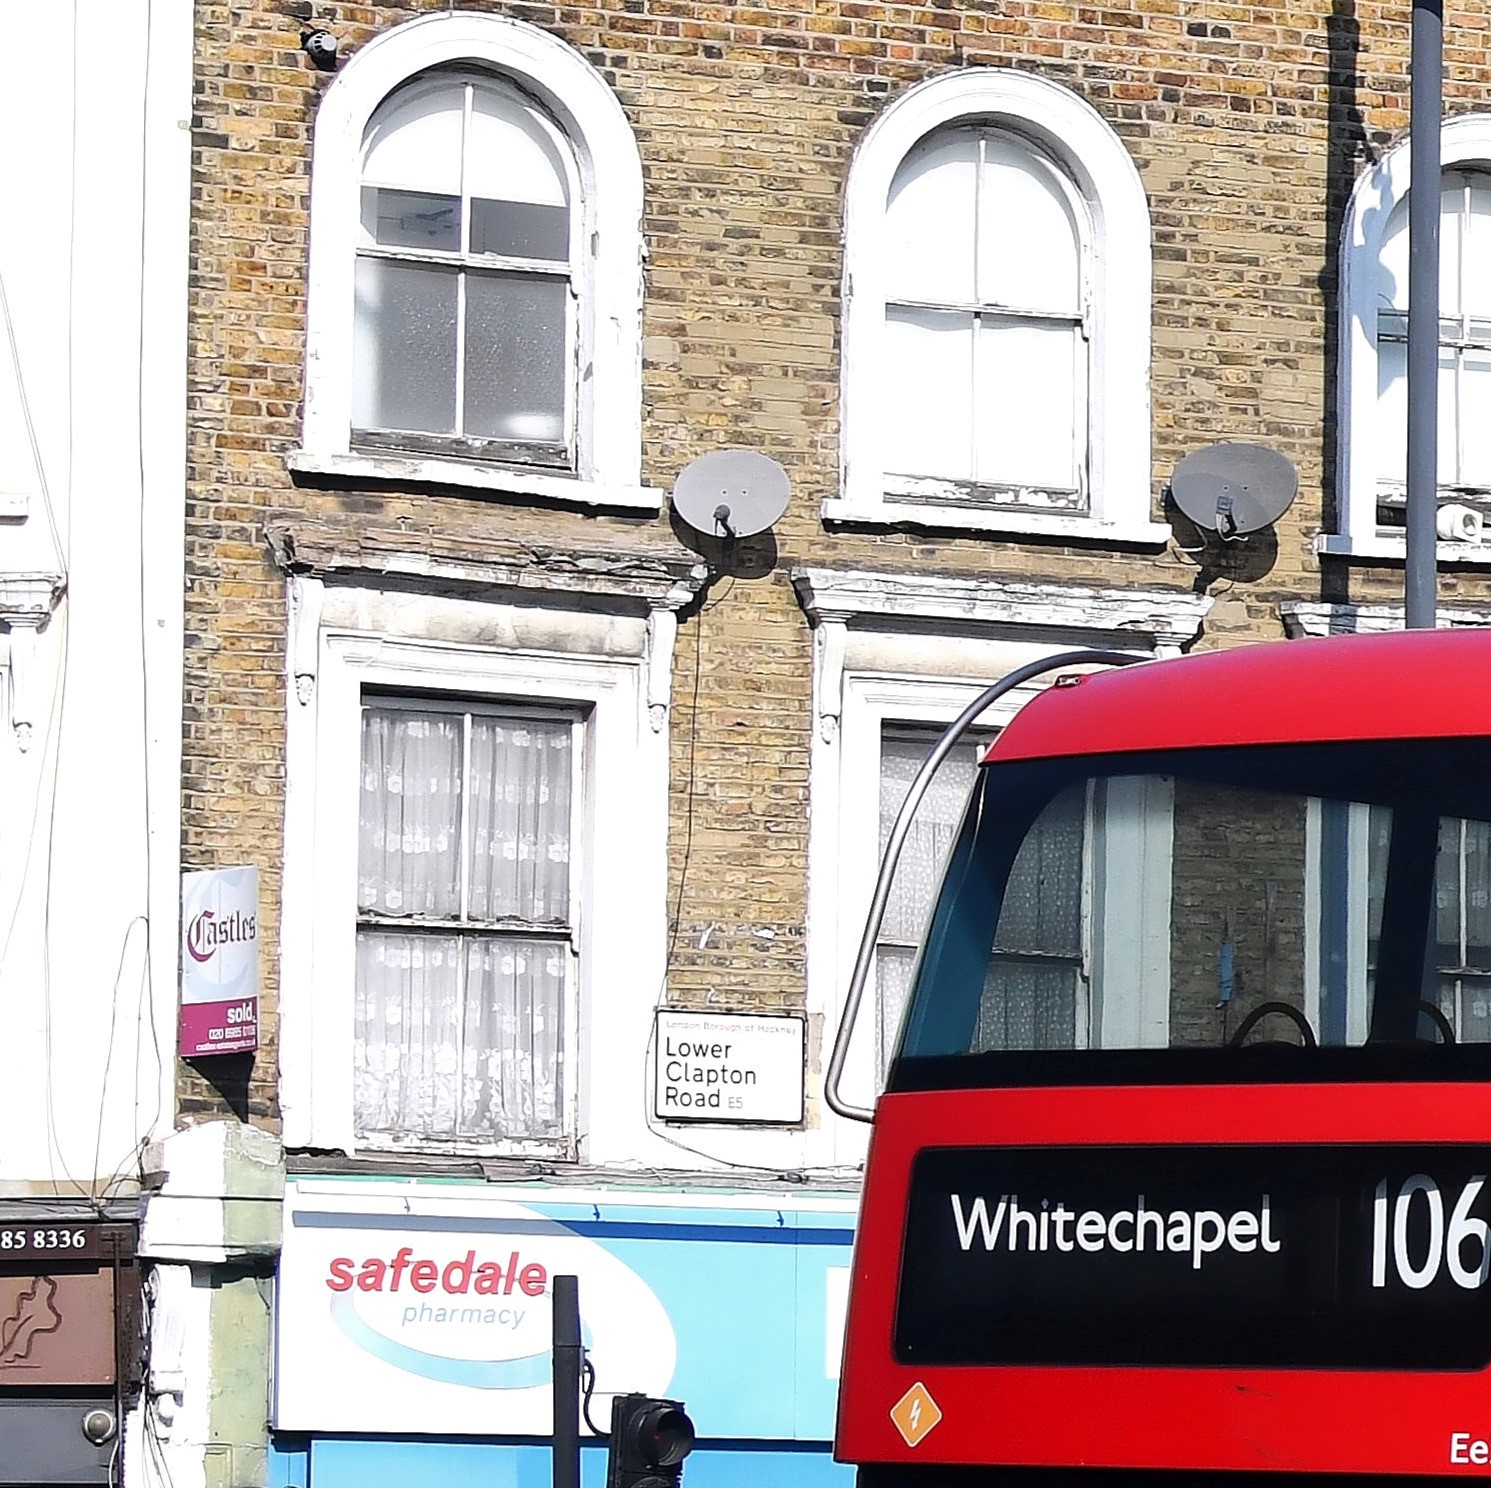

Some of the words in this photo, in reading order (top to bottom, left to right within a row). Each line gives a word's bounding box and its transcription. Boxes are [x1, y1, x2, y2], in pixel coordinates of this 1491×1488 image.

[187, 910, 256, 962] Castles
[666, 1036, 732, 1058] Lower
[666, 1061, 756, 1086] Clapton
[665, 1086, 720, 1108] Road
[728, 1096, 743, 1109] E5
[33, 1229, 86, 1249] 8336
[951, 1193, 1281, 1269] Whitechapel
[325, 1247, 548, 1297] safedale
[402, 1302, 526, 1330] pharmacy
